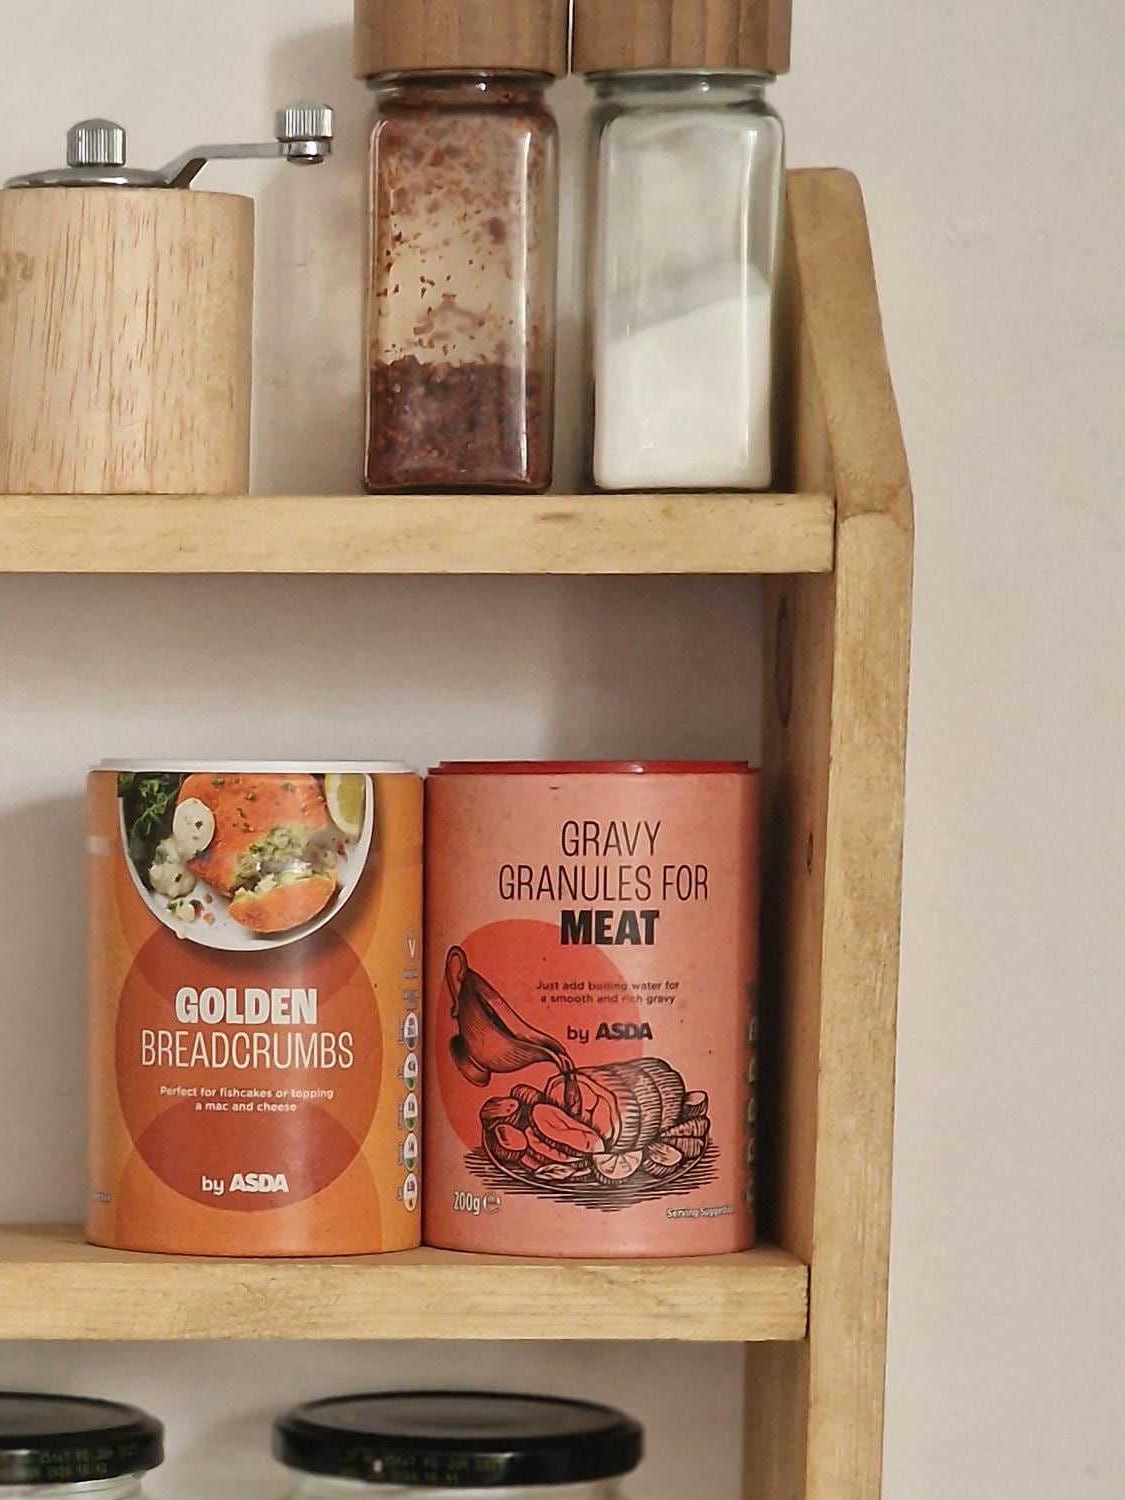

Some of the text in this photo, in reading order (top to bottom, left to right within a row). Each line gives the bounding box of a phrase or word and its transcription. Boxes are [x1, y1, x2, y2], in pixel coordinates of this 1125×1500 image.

[561, 821, 661, 857] GRAVY
[499, 864, 708, 901] GRANULES FOR
[560, 909, 660, 945] MEAT
[536, 980, 559, 990] Just
[562, 980, 584, 991] add
[632, 981, 662, 990] water
[665, 980, 679, 990] for
[175, 987, 317, 1025] GOLDEN
[551, 994, 593, 1003] smooth
[597, 994, 618, 1003] and
[646, 995, 676, 1005] gravy
[567, 1022, 653, 1043] by ASDA
[141, 1029, 354, 1069] BREADCRUMBS
[160, 1086, 334, 1100] Perfect for fishcakes or topping
[195, 1102, 297, 1112] a mac and cheese
[201, 1174, 290, 1195] by ASDA
[453, 1191, 480, 1216] 200g
[667, 1208, 699, 1219] Serving
